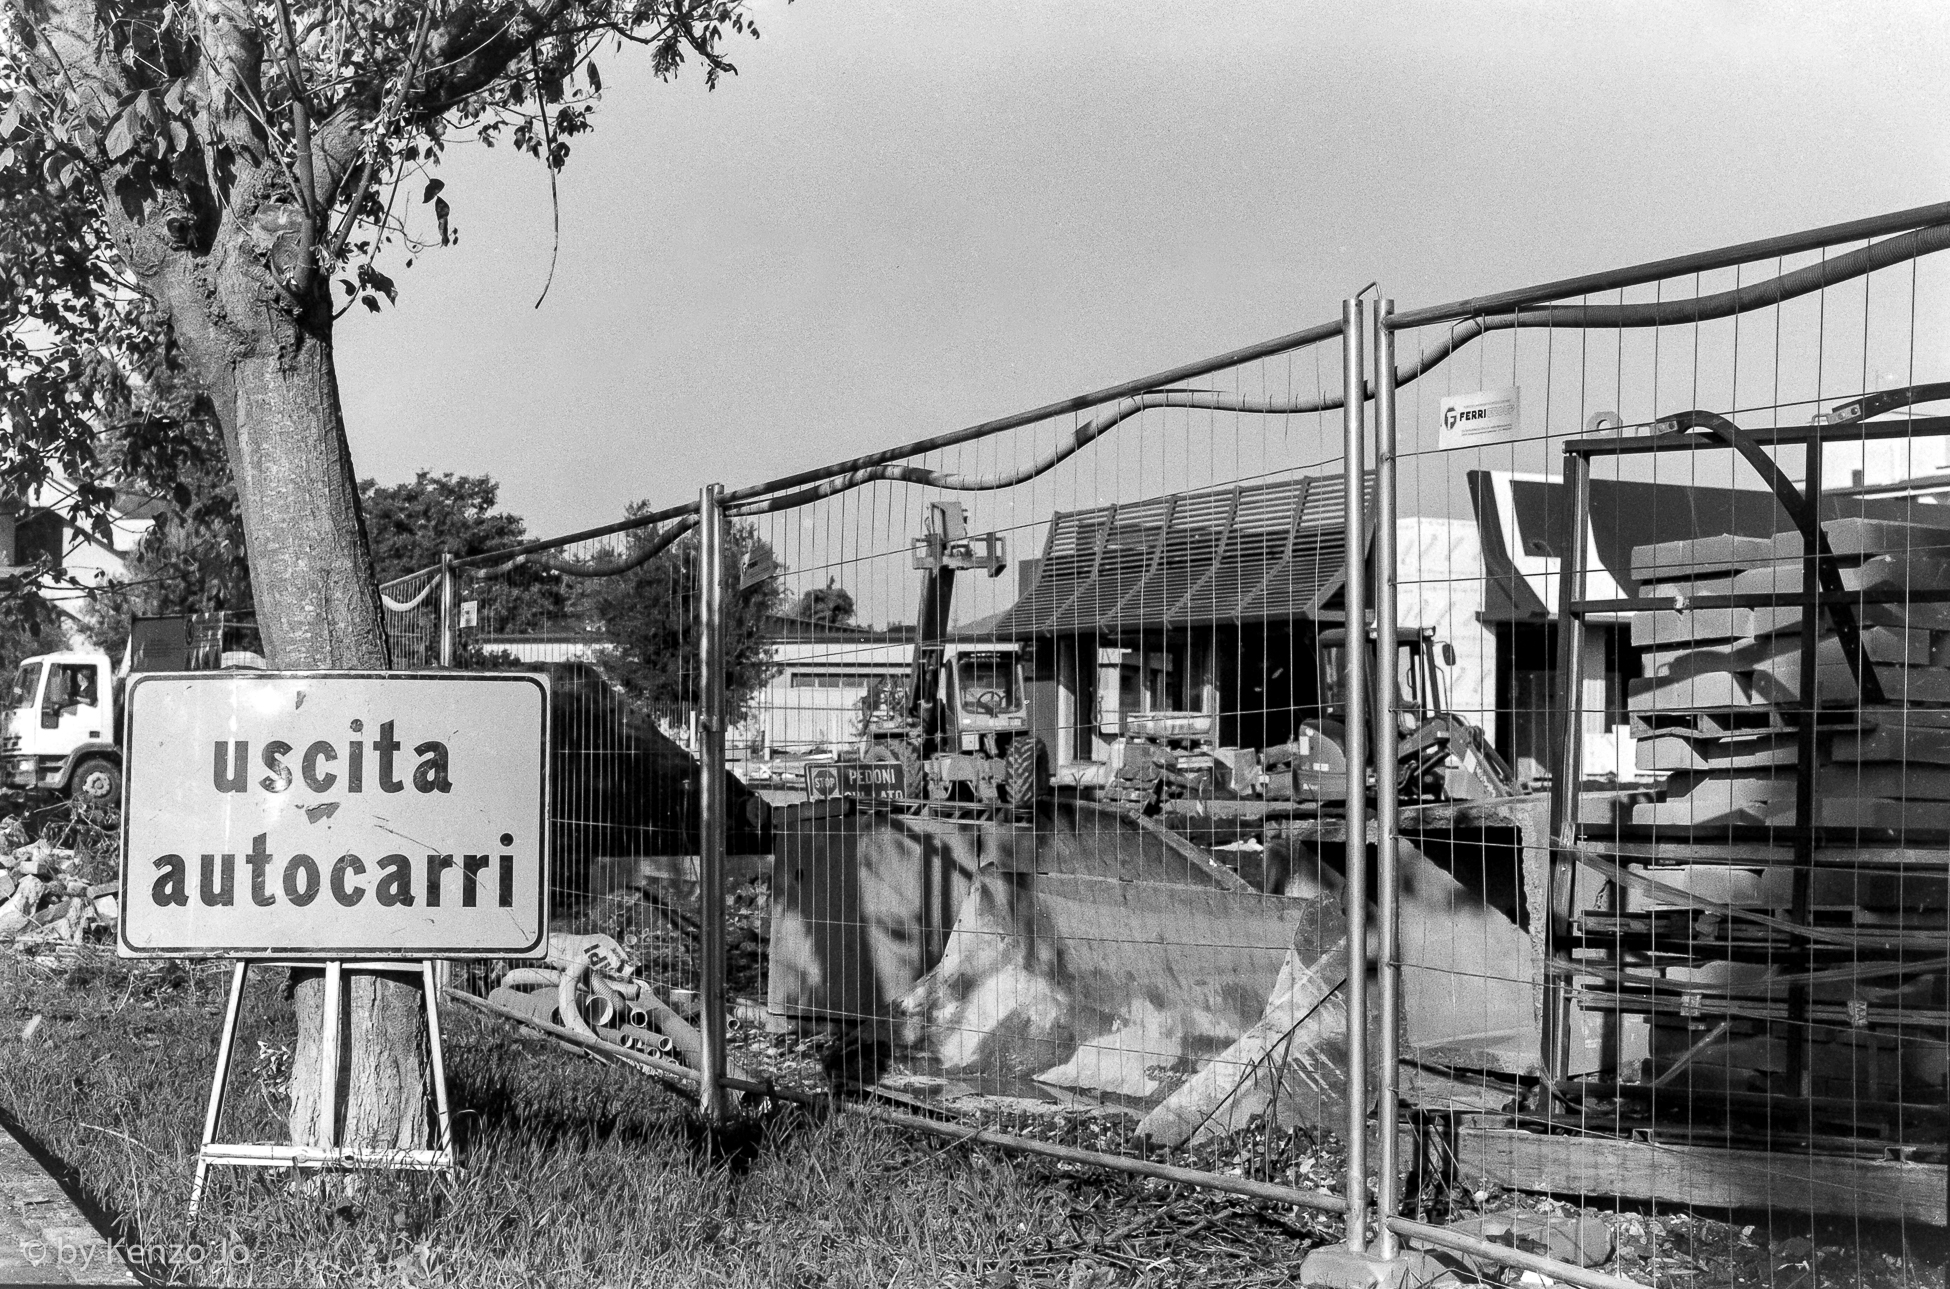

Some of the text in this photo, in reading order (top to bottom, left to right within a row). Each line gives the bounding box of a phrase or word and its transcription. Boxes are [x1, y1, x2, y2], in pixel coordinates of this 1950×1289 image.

[1460, 409, 1487, 421] FERRI
[213, 719, 453, 794] uscita
[814, 777, 836, 788] STOP
[849, 768, 896, 784] PEDONI
[151, 832, 514, 907] autocarri
